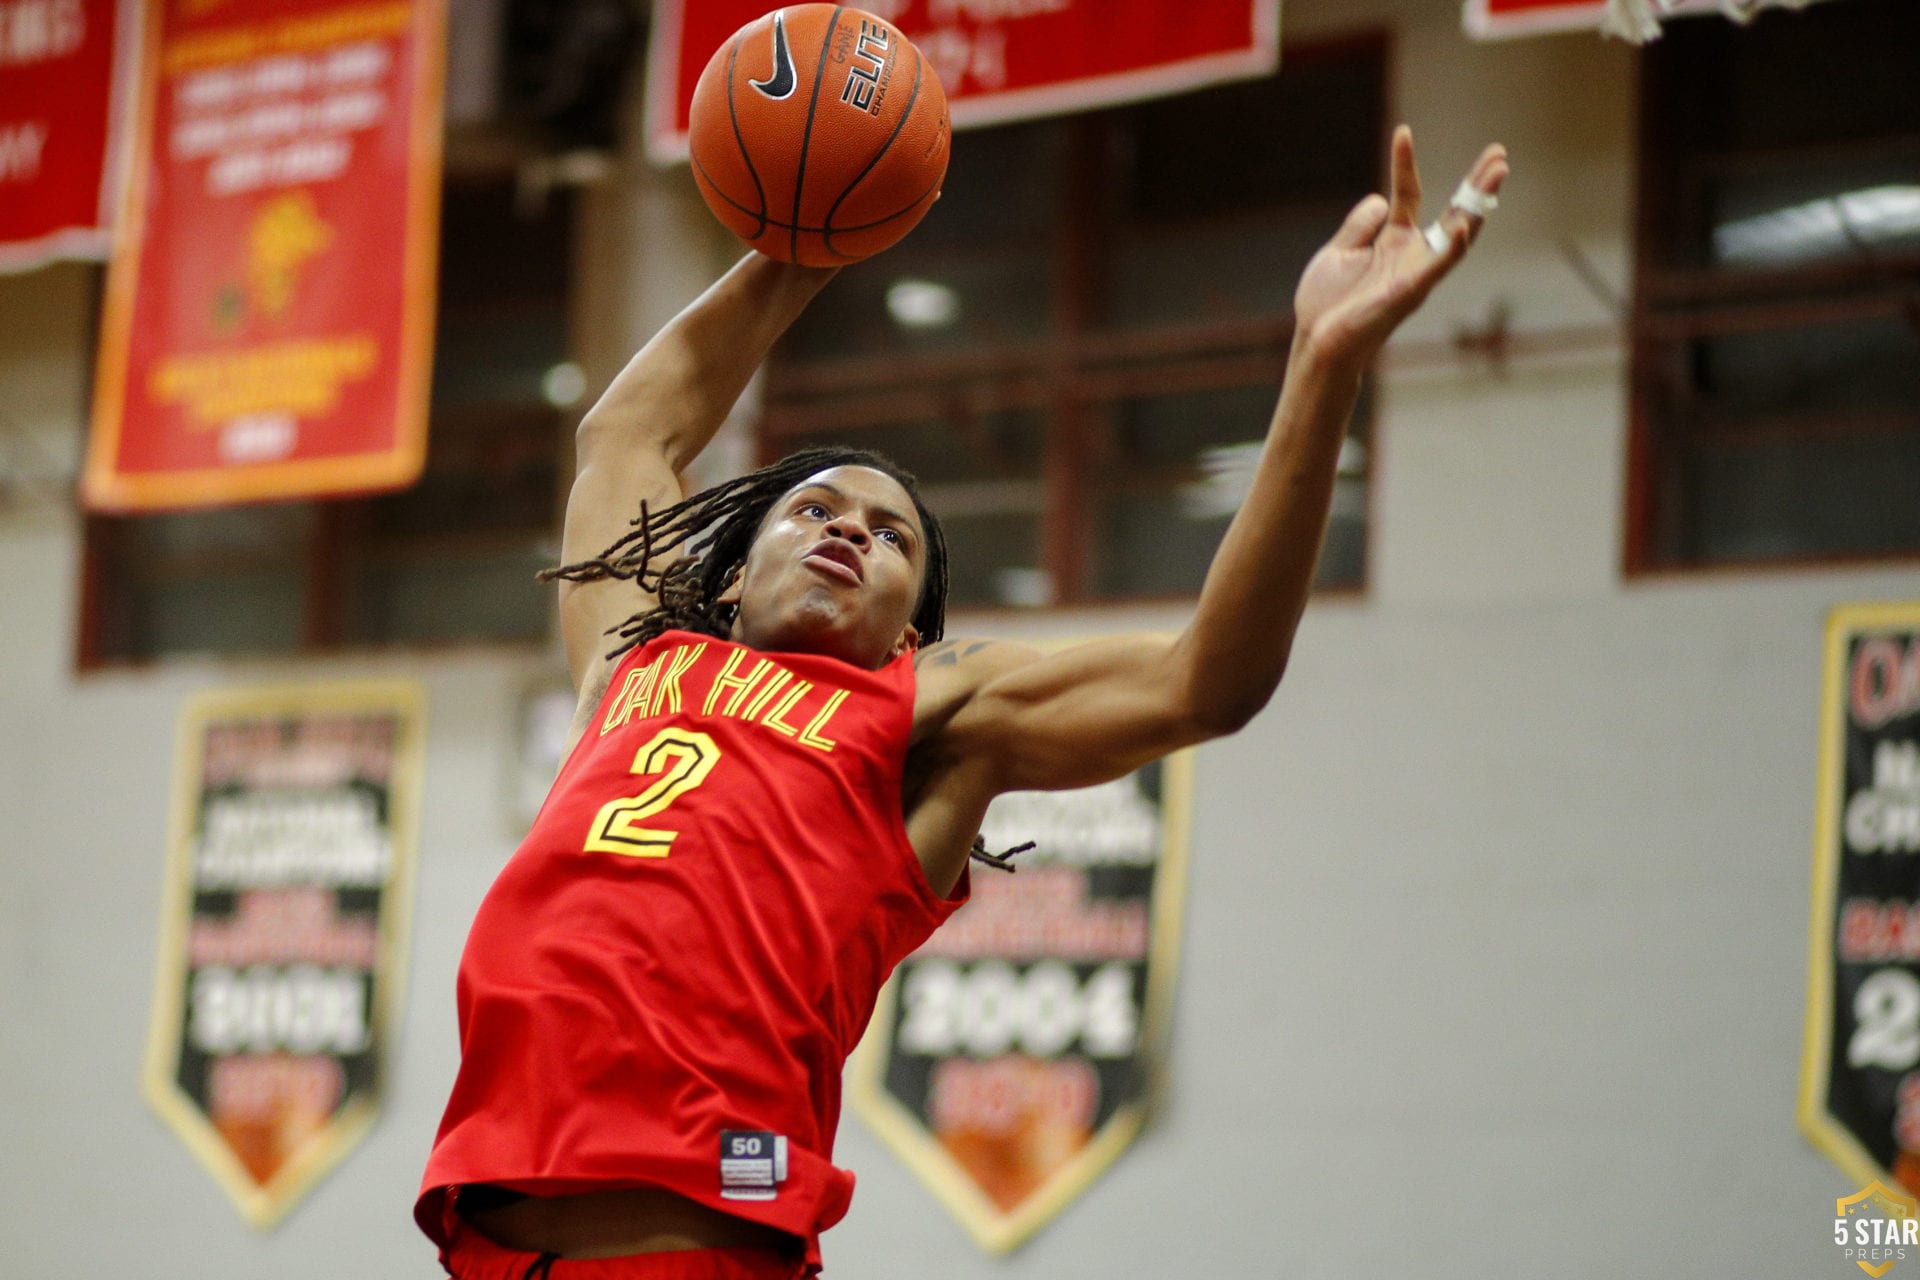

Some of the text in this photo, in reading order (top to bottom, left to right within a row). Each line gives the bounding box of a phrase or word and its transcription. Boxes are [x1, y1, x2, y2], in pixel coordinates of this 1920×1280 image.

[840, 19, 889, 114] ELITE
[600, 642, 851, 752] OAK HILL
[583, 727, 722, 858] 2
[731, 1137, 762, 1156] 50
